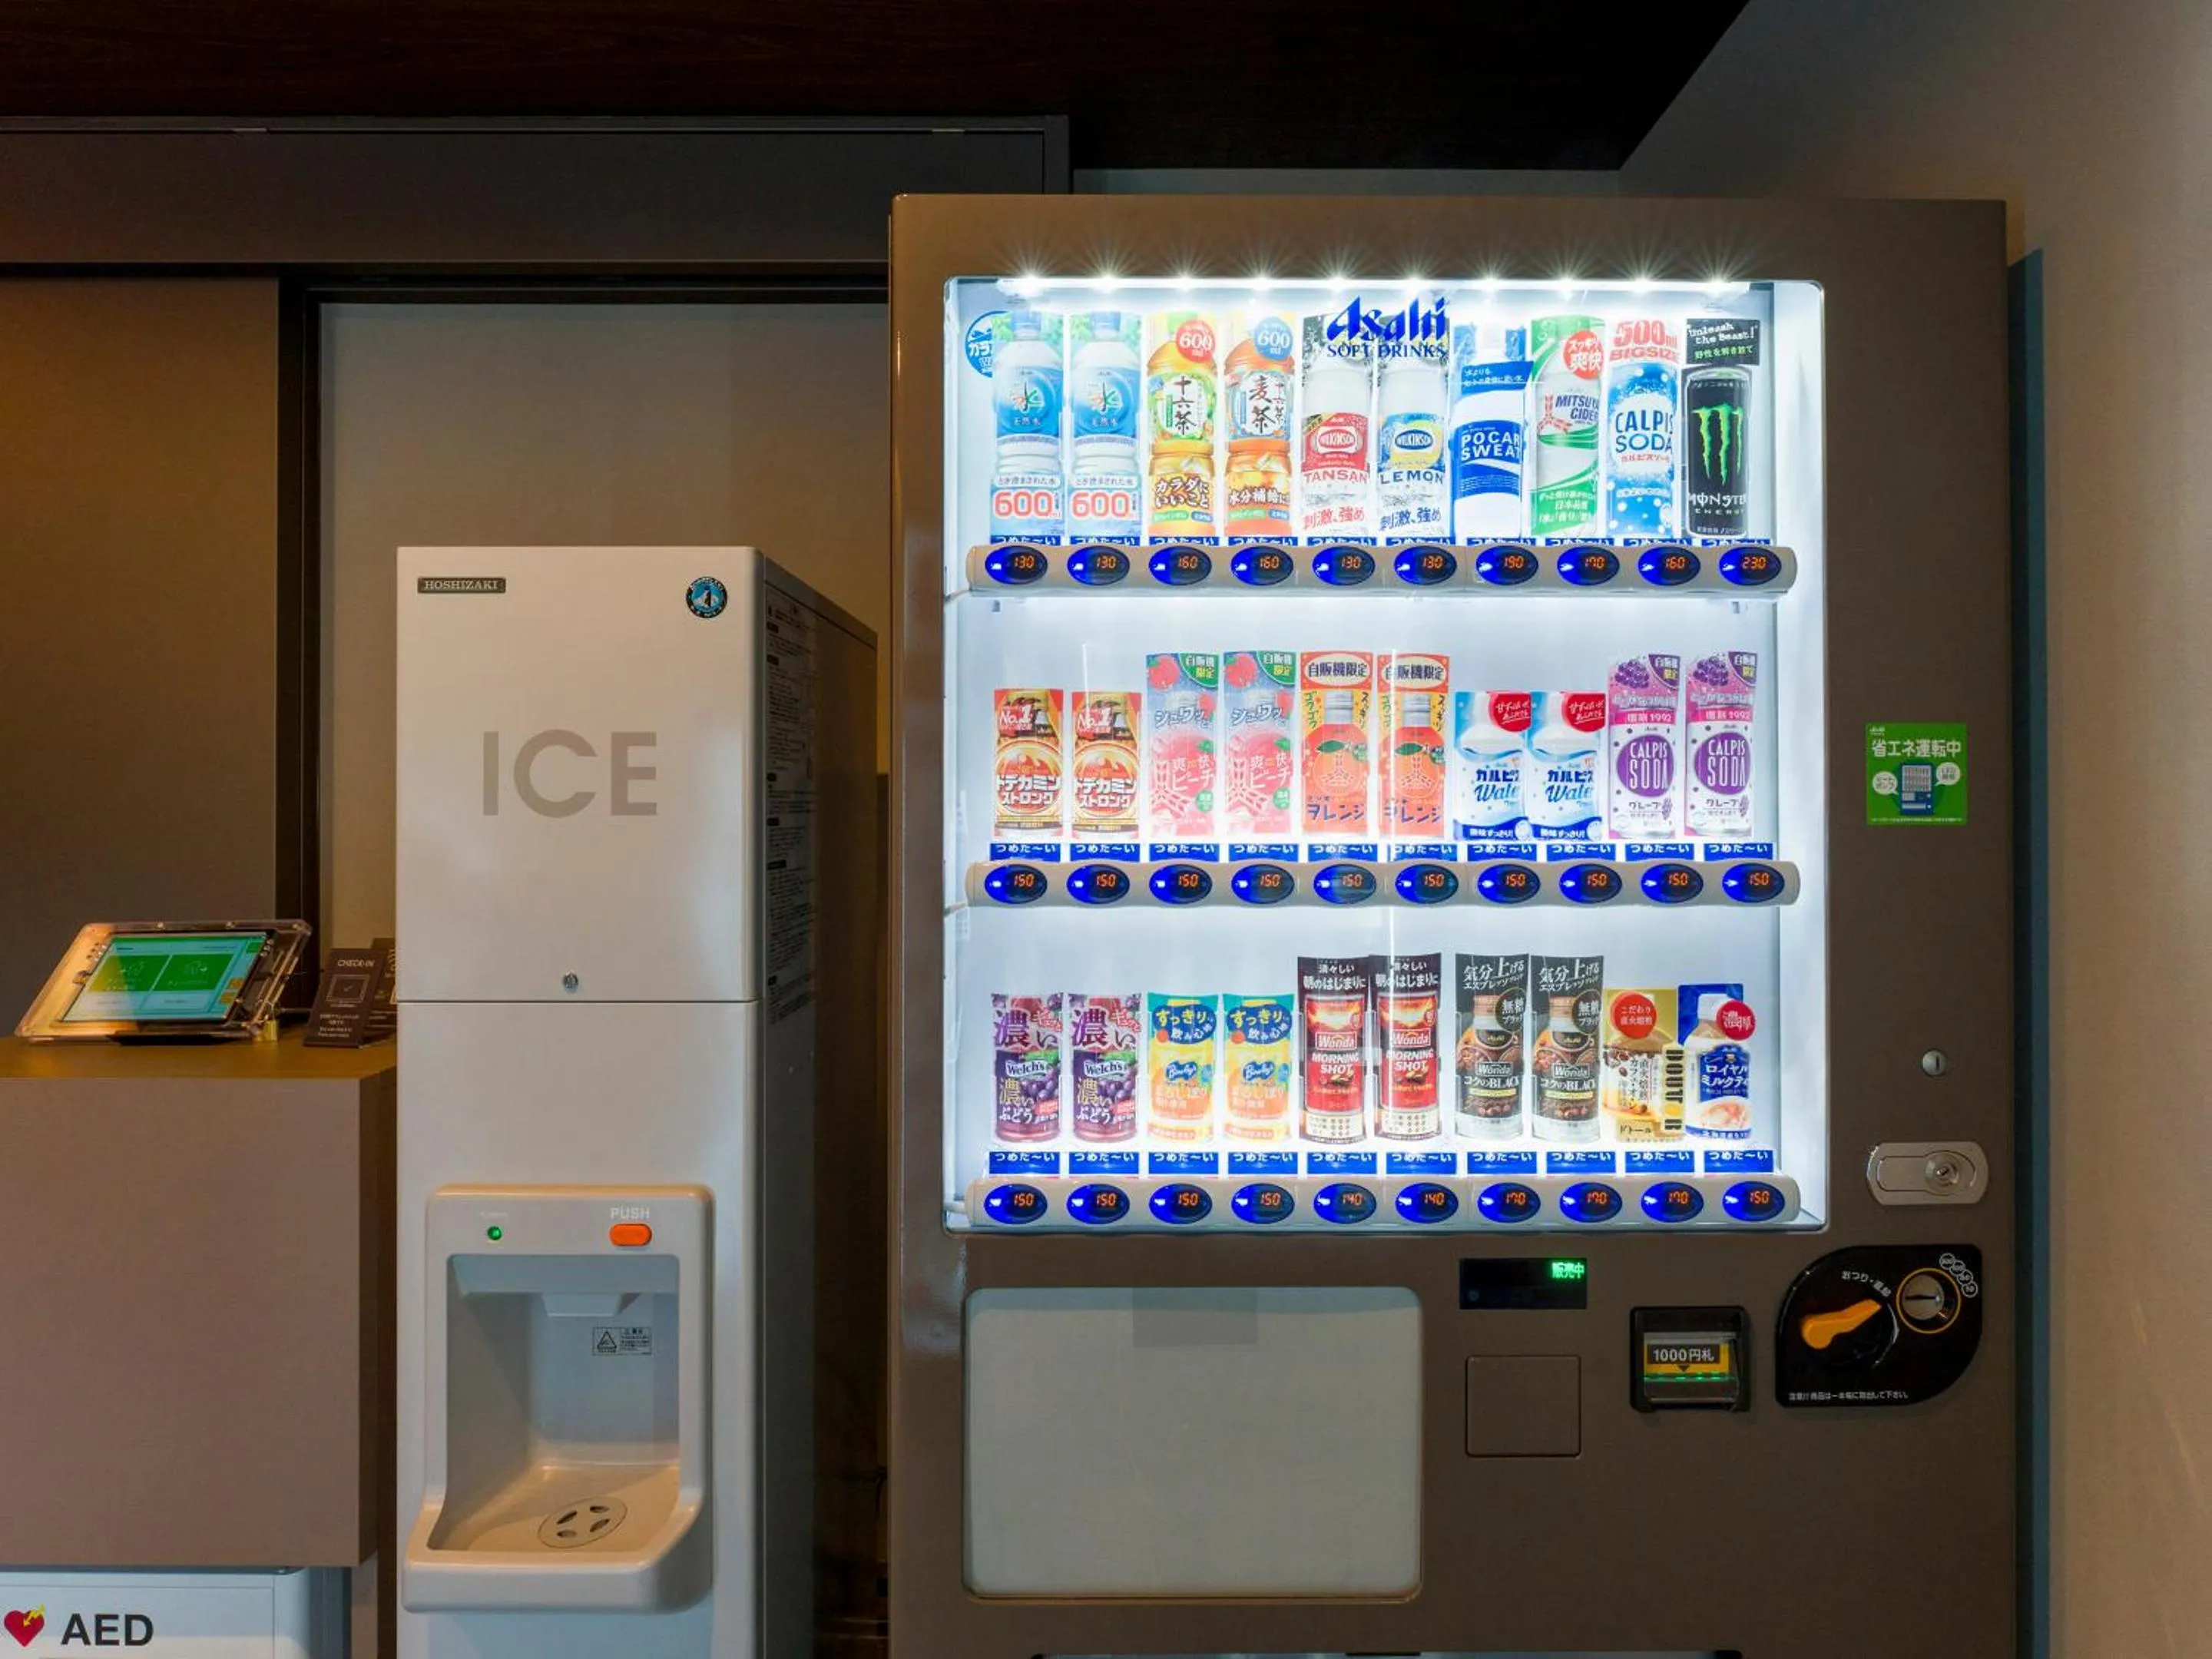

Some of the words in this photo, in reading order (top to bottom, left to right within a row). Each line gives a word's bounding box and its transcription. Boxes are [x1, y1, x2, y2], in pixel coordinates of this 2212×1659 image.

[1327, 295, 1446, 341] Asahi
[1327, 343, 1373, 358] SOFT
[1377, 343, 1448, 358] DRINKS
[1173, 376, 1197, 435] 十六茶
[1248, 375, 1276, 434] 麦茶
[1303, 469, 1369, 485] TANSAN
[1379, 470, 1444, 485] LEMON
[1154, 476, 1210, 495] カラダに
[1154, 493, 1210, 509] いいこと
[1015, 555, 1035, 569] 130
[1097, 555, 1116, 569] 130
[1178, 555, 1198, 569] 160
[1260, 555, 1280, 569] 160
[1342, 555, 1362, 569] 130
[1423, 555, 1443, 569] 130
[1505, 555, 1525, 569] 190
[1585, 555, 1605, 569] 170
[1666, 555, 1685, 569] 160
[1743, 555, 1767, 569] 230
[424, 580, 498, 591] HOSHIZAKI
[1307, 661, 1368, 678] 自販機限定
[1384, 665, 1444, 680] 自販機限定
[1629, 741, 1668, 759] CALPIS
[1708, 739, 1746, 756] CALPIS
[1871, 739, 1962, 758] 省エネ運転中
[482, 729, 657, 819] ICE
[1629, 758, 1669, 790] SODA
[1707, 756, 1746, 787] SODA
[1001, 791, 1054, 806] ストロング
[1078, 794, 1131, 809] ストロング
[1013, 873, 1035, 887] 150
[1097, 873, 1116, 887] 150
[1178, 873, 1198, 887] 150
[1260, 873, 1280, 887] 150
[1343, 873, 1362, 887] 150
[1425, 873, 1444, 887] 150
[1505, 873, 1525, 887] 150
[1588, 873, 1607, 887] 150
[1668, 873, 1687, 887] 150
[1750, 873, 1770, 887] 150
[1303, 975, 1367, 991] 朝のはじまりに
[1155, 1008, 1207, 1027] すっきり
[1230, 1008, 1283, 1028] すっきり
[993, 1008, 1059, 1046] 濃い
[1071, 1008, 1136, 1046] 濃い
[1318, 1034, 1356, 1048] Wonda
[1393, 1031, 1429, 1046] Wonda
[1312, 1051, 1359, 1063] MORNING
[1386, 1049, 1434, 1061] MORNING
[1007, 1061, 1046, 1074] Welch's
[1084, 1061, 1124, 1074] Welch's
[1320, 1063, 1353, 1075] SHOT
[1393, 1061, 1429, 1071] SHOT
[1014, 1193, 1033, 1206] 150
[1096, 1193, 1116, 1206] 150
[1178, 1193, 1198, 1206] 150
[1260, 1193, 1281, 1206] 150
[1343, 1193, 1362, 1206] 140
[1425, 1193, 1445, 1206] 140
[1506, 1193, 1525, 1206] 170
[1587, 1193, 1607, 1206] 170
[1669, 1193, 1688, 1206] 170
[1750, 1193, 1769, 1206] 150
[611, 1207, 650, 1220] PUSH
[1652, 1348, 1714, 1363] 1000円札
[60, 1612, 154, 1647] AED
